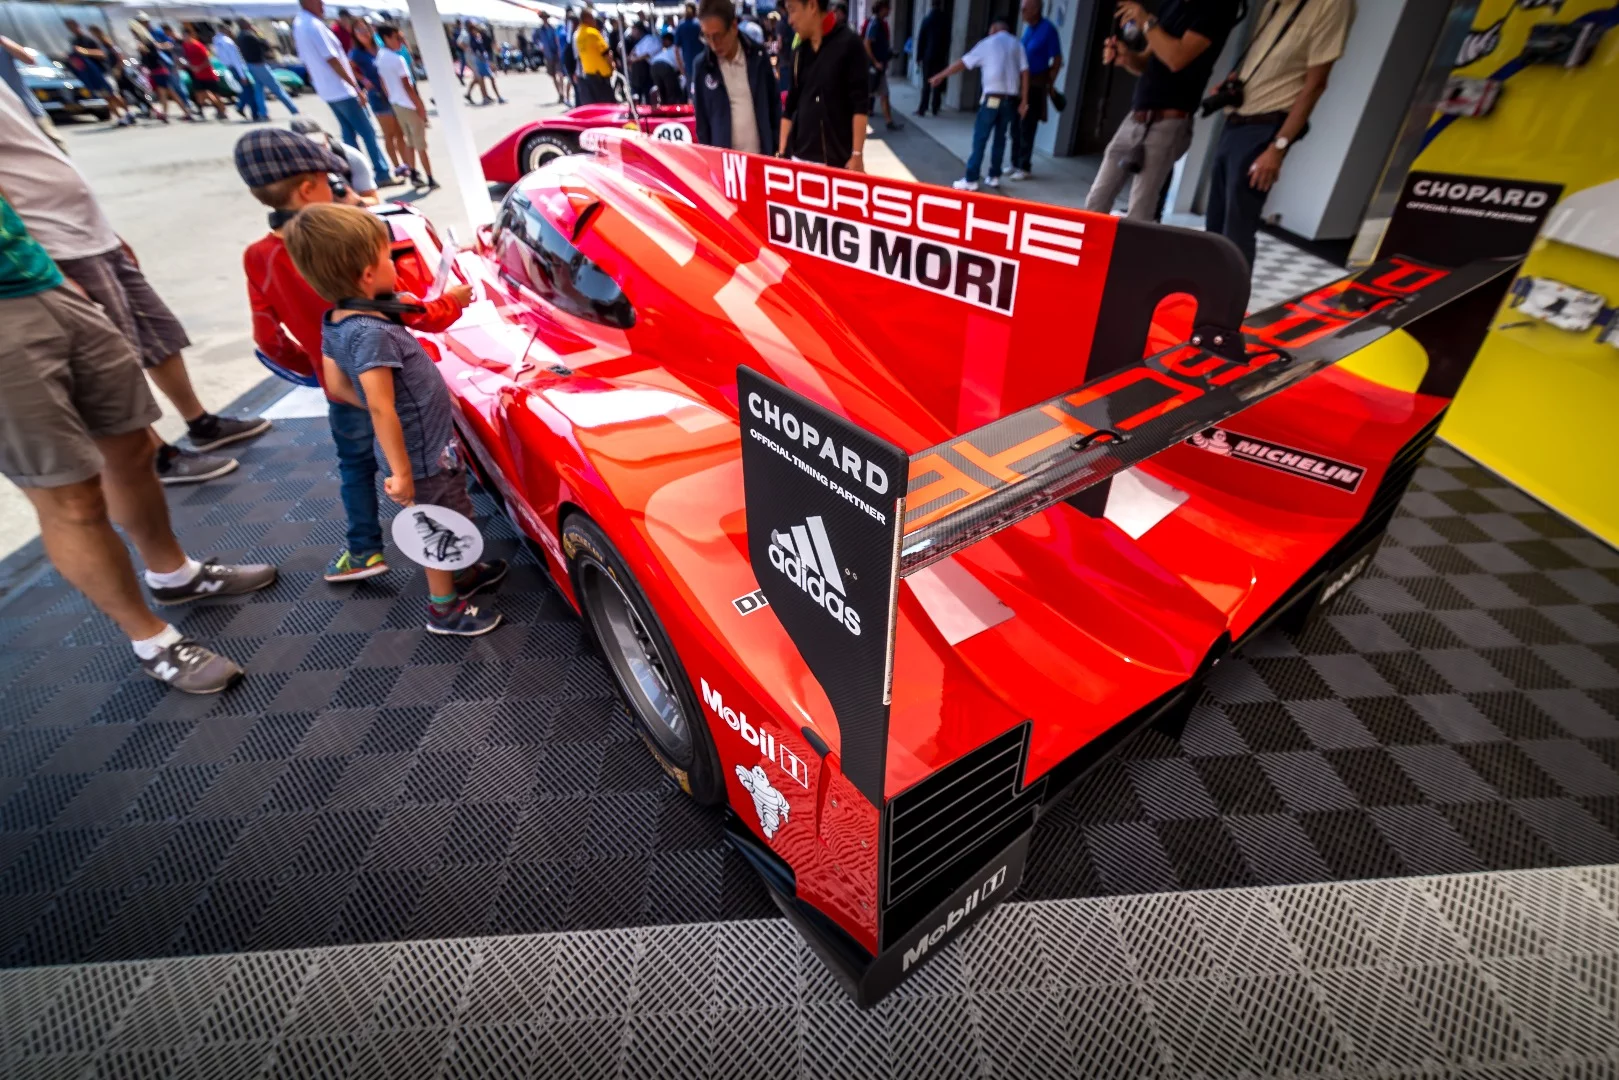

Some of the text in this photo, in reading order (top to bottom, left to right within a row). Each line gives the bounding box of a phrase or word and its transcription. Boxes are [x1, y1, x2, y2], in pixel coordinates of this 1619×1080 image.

[722, 153, 747, 201] HY
[764, 165, 1085, 266] PORSCHE
[1413, 180, 1548, 208] CHOPARD
[768, 204, 1016, 311] DMG MORI
[748, 392, 889, 495] CHOPARD
[750, 428, 886, 525] OFFICIAL TIMING PARTNER
[1235, 440, 1359, 484] MICHELIN
[768, 544, 861, 636] adidas
[700, 677, 775, 762] Mobil
[902, 888, 980, 972] Mobil
